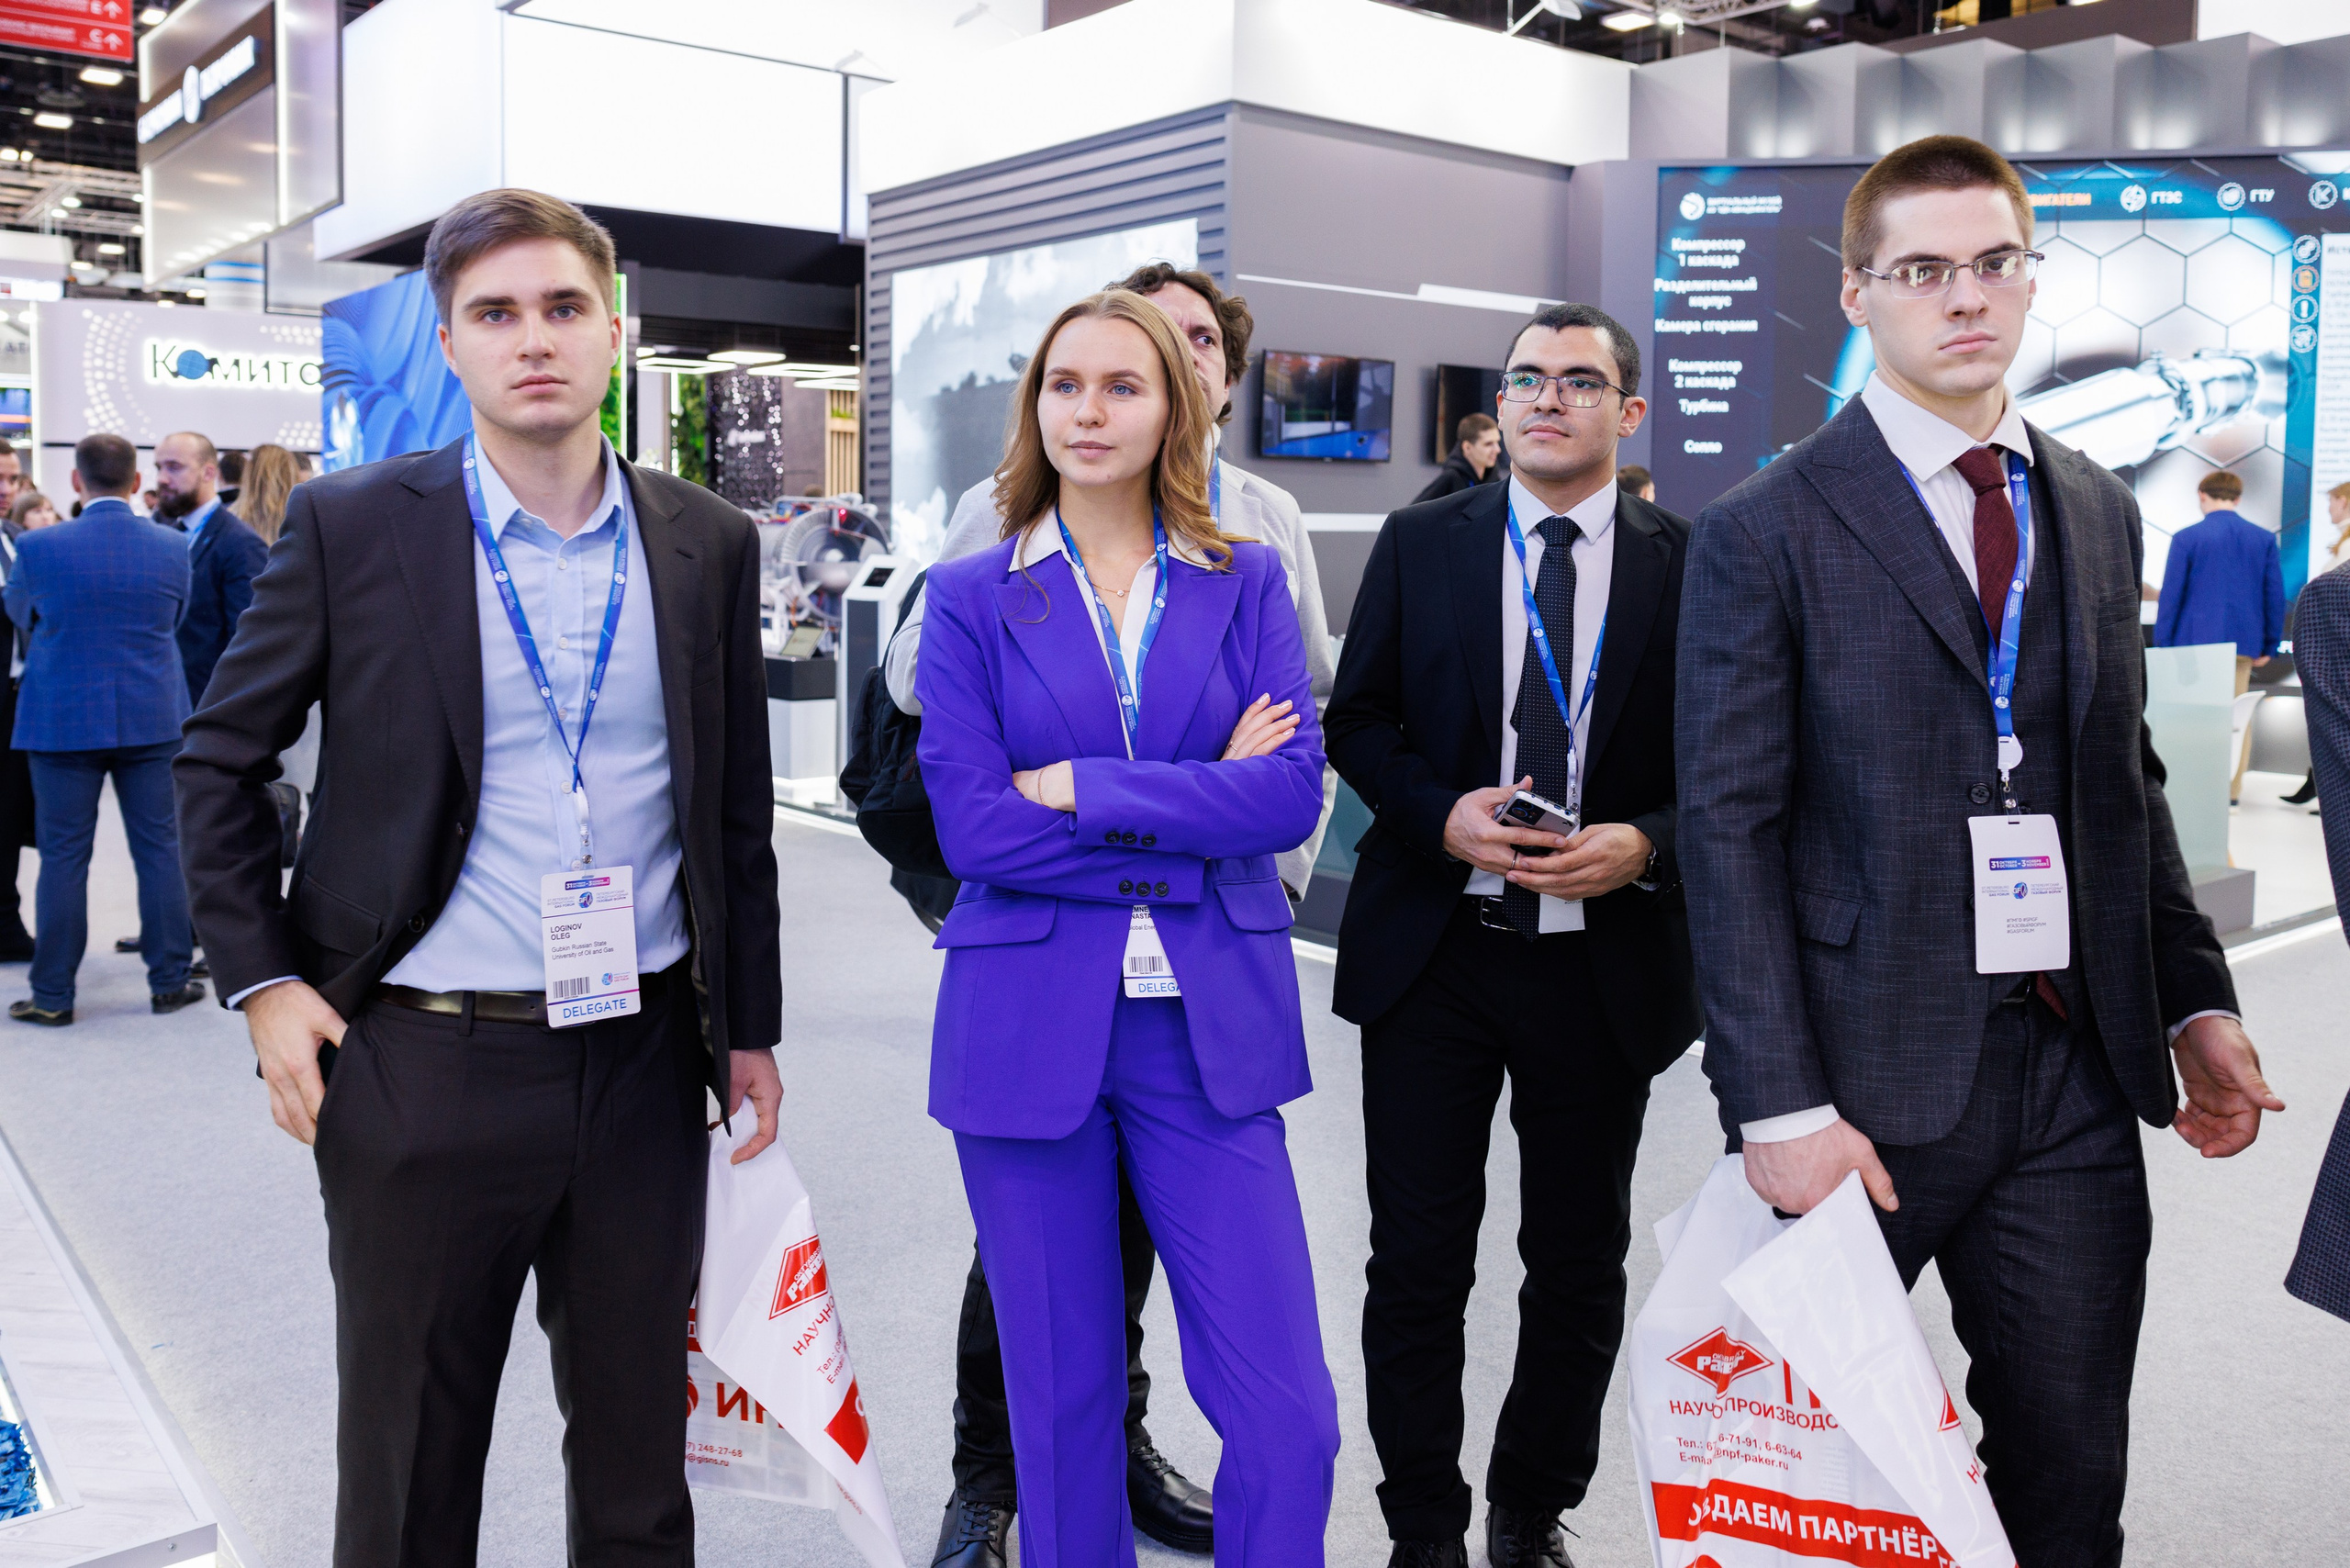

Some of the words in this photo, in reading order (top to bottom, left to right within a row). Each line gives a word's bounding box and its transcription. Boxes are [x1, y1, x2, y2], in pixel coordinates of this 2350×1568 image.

[2027, 193, 2091, 207] ВИГАТЕЛИ
[2250, 188, 2276, 203] ГТУ
[1672, 238, 1746, 253] Компрессор
[1678, 253, 1685, 267] 1
[1687, 255, 1740, 268] каскада
[1654, 276, 1758, 294] Разделительный
[1688, 296, 1732, 310] корпус
[1654, 319, 1701, 334] Камера
[1702, 319, 1758, 334] сгорания
[1668, 359, 1742, 375] Компрессор
[1674, 375, 1684, 388] 2
[1684, 376, 1736, 390] каскада
[1678, 398, 1729, 415] Турбина
[1684, 440, 1723, 454] Сопло
[1991, 860, 1999, 868] 31
[550, 924, 582, 933] LOGINOV
[551, 932, 570, 940] OLEG
[552, 952, 576, 960] University
[563, 998, 627, 1019] DELEGATE
[1724, 1396, 1839, 1431] ПРОИЗВОДС
[698, 1443, 744, 1458] 248-27-68
[1676, 1437, 1703, 1449] Тел.:
[1765, 1440, 1803, 1461] 6-63-64
[1799, 1515, 1938, 1560] ПАРТНЁР
